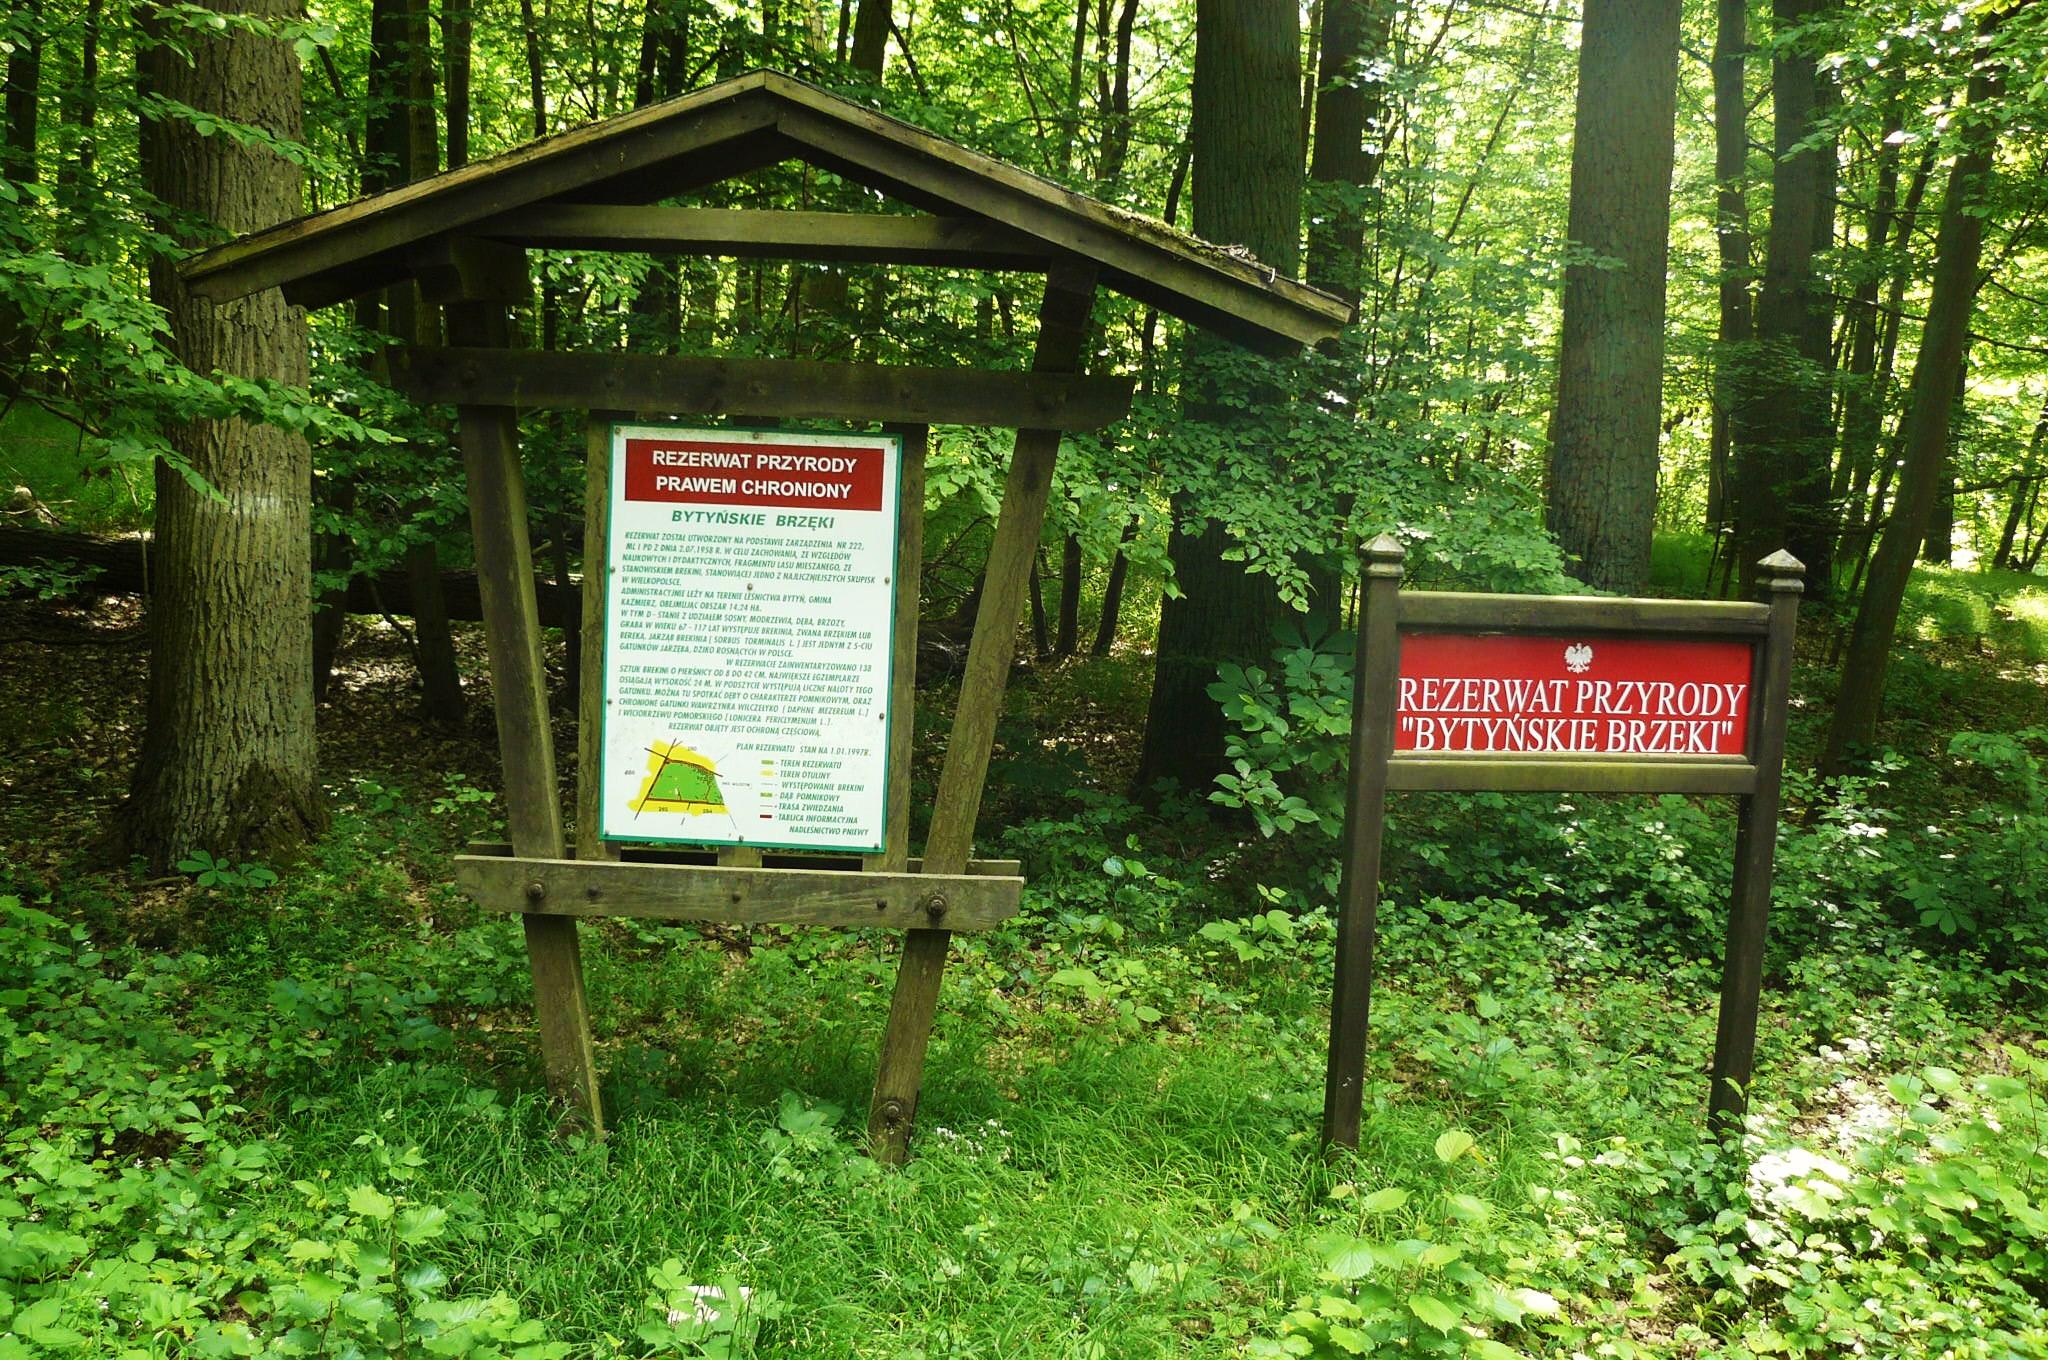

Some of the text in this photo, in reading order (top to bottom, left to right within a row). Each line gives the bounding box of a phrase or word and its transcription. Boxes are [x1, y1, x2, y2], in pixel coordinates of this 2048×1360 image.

[653, 451, 857, 473] REZERWAT PRZYRODY
[656, 476, 851, 498] PRAWEM CHRONIONY
[671, 508, 834, 530] BYTYŃSKIE BRZĘKI
[688, 534, 731, 543] UTWORZONY
[734, 536, 743, 544] NA
[745, 537, 783, 546] PODSTAWIE
[836, 541, 846, 549] NR
[660, 544, 677, 552] DNIA
[733, 547, 749, 555] CELU
[622, 553, 665, 562] NAUKOWYCH
[734, 559, 774, 567] FRAGMENTU
[622, 564, 672, 574] STANOWISKIEM
[753, 571, 774, 579] JEDNO
[847, 576, 875, 584] SKUPISK
[621, 586, 684, 596] ADMINISTRACYJNIE
[704, 590, 714, 598] NA
[716, 591, 741, 599] TERENIE
[808, 596, 831, 604] GMINA
[700, 602, 726, 610] OBSZAR
[630, 609, 644, 617] TYM
[657, 611, 679, 619] STANIE
[708, 624, 720, 632] LAT
[796, 629, 821, 637] ZWANA
[693, 646, 714, 654] DZIKO
[802, 640, 816, 648] JEST
[817, 641, 844, 649] JEDNYM
[778, 660, 856, 671] ZAINWENTARYZOWANO
[619, 664, 640, 672] SZTUK
[812, 674, 859, 683] EGZEMPLARZE
[723, 680, 760, 689] PODSZYCIE
[802, 684, 824, 693] LICZNE
[855, 687, 872, 695] TEGO
[750, 693, 797, 702] CHARAKTERZE
[853, 698, 871, 706] ORAZ
[1397, 678, 1746, 717] REZERWAT PRZYRODY
[659, 699, 688, 708] GATUNKI
[668, 722, 703, 730] REZERWAT
[1402, 713, 1598, 752] "BYTYŃSKIE
[736, 742, 753, 750] PLAN
[755, 743, 795, 752] REZERWATU
[799, 745, 815, 753] STAN
[818, 746, 827, 754] NA
[780, 759, 841, 769] TEREN REZERWATU
[801, 771, 830, 779] OTULINY
[837, 784, 864, 792] BREKINI
[796, 793, 839, 801] POMNIKOWY
[778, 802, 843, 812] TRASA ZWIEDZANIA
[778, 813, 857, 824] TABLICA INFORMACYJNA
[842, 827, 868, 836] PNIEWY
